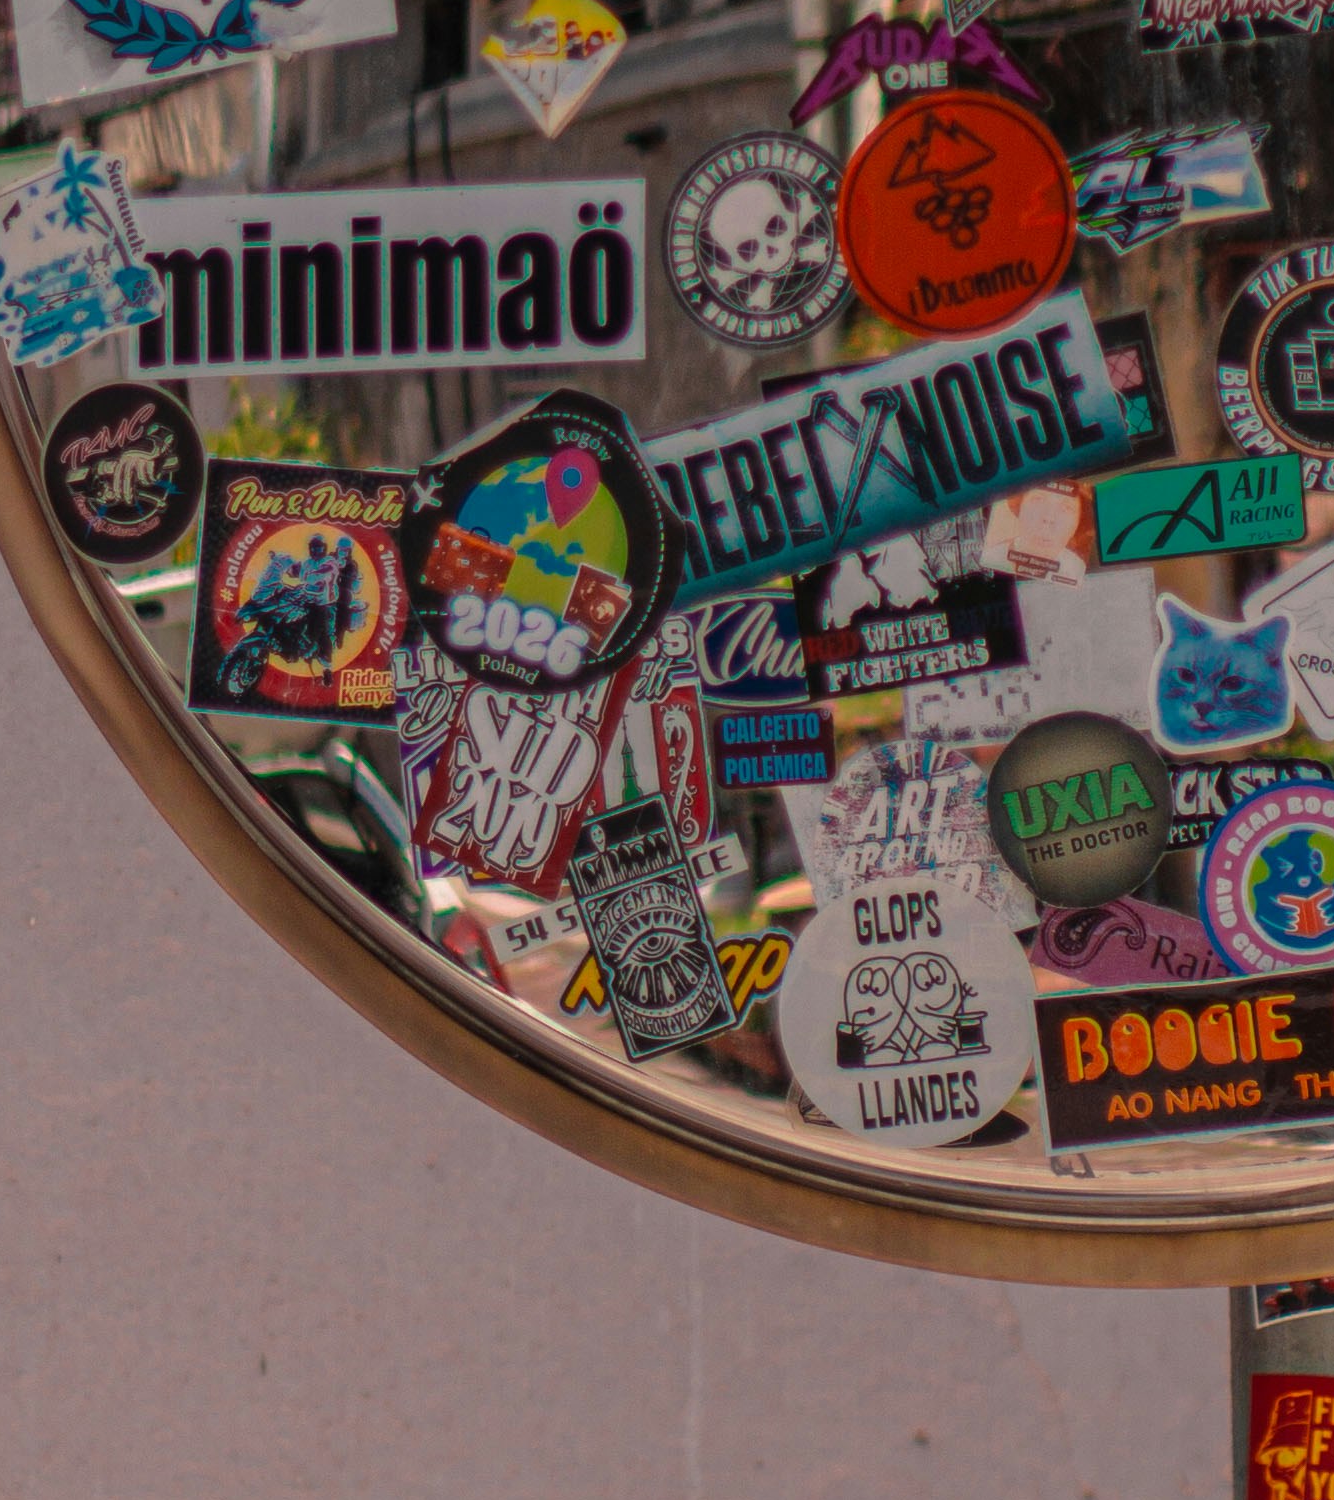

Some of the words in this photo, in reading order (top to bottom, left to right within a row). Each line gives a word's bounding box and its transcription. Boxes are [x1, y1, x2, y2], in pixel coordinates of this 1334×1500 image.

[884, 61, 949, 91] ONE
[106, 159, 147, 255] Sarawak
[136, 200, 635, 368] minimaö
[1247, 256, 1299, 310] TIK
[553, 426, 612, 464] Rogów
[653, 414, 864, 585] REBEL
[894, 321, 1105, 508] NOISE
[1218, 366, 1323, 490] BEERPOG
[287, 498, 303, 517] &
[1228, 465, 1279, 505] AJI
[448, 593, 590, 676] 2026
[860, 613, 951, 653] WHITE
[479, 653, 540, 686] Poland
[826, 638, 990, 693] FIGHTERS
[339, 687, 397, 708] Kenya
[722, 712, 821, 744] CALCETTO
[724, 752, 828, 784] POLEMICA
[431, 767, 562, 873] 2019
[854, 779, 958, 843] ART
[1002, 762, 1155, 840] UXIA
[1026, 843, 1065, 864] THE
[1071, 821, 1150, 854] DOCTOR
[1225, 801, 1281, 858] READ
[852, 889, 943, 946] GLOPS
[1215, 876, 1238, 929] AND
[504, 918, 549, 953] 54
[1062, 994, 1303, 1084] BOOGIE
[858, 1070, 981, 1130] LLANDES
[1106, 1090, 1154, 1122] AO
[1165, 1079, 1262, 1115] NANG
